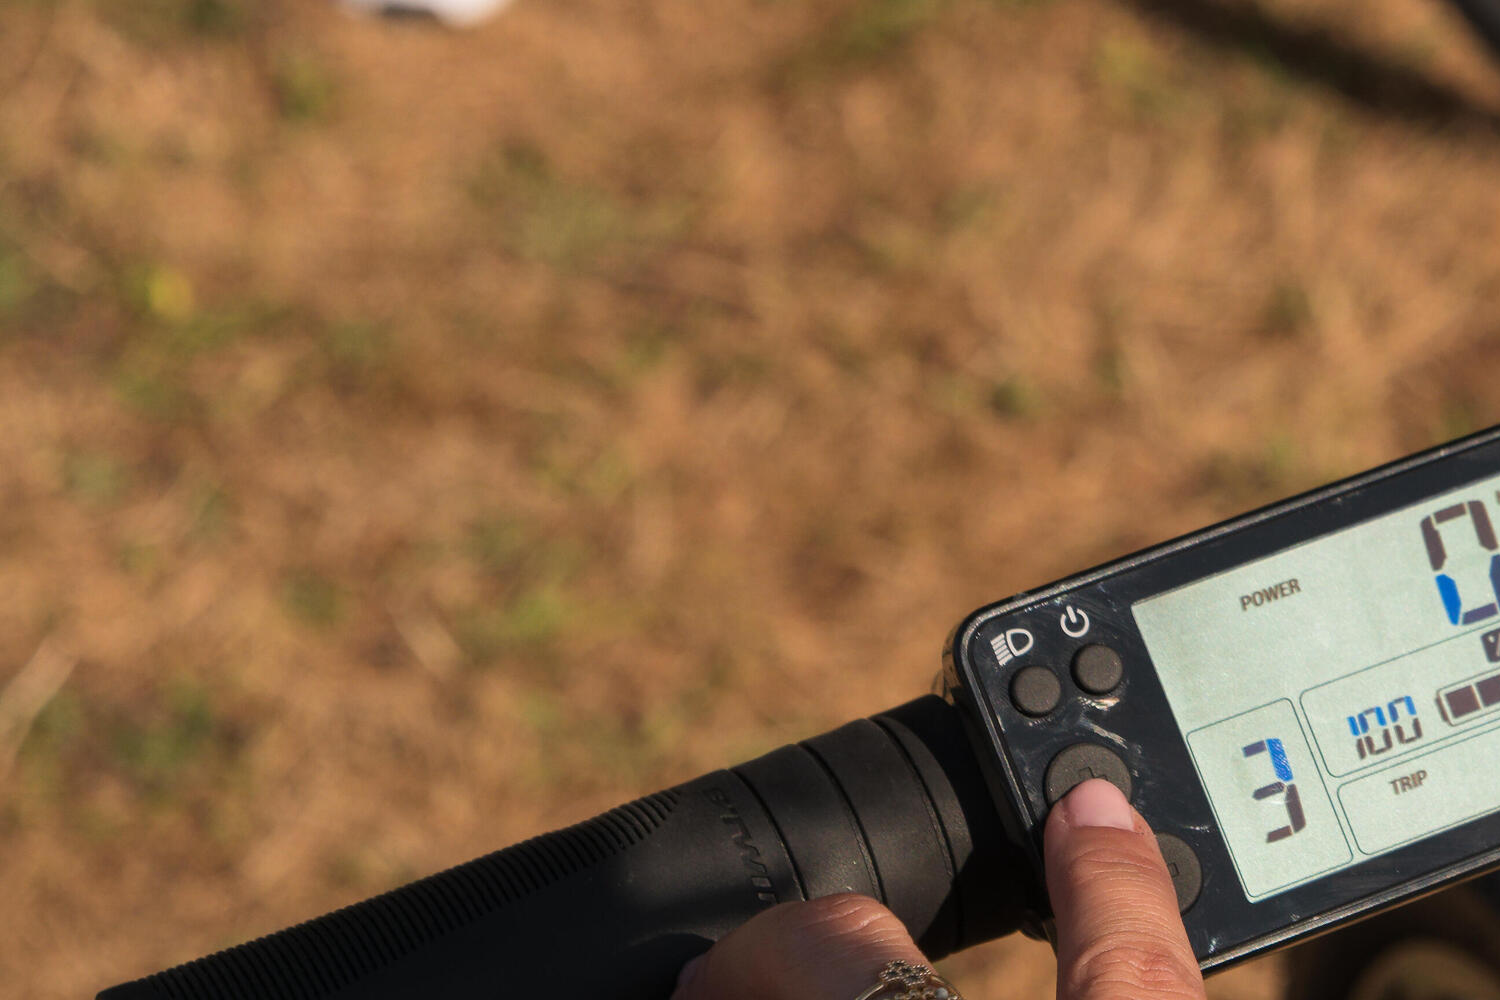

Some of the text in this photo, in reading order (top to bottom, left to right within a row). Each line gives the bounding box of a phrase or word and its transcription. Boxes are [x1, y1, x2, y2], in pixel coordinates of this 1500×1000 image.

[1239, 578, 1302, 612] POWER
[1347, 695, 1423, 760] 100
[1241, 738, 1307, 844] 3
[1389, 769, 1429, 796] TRIP
